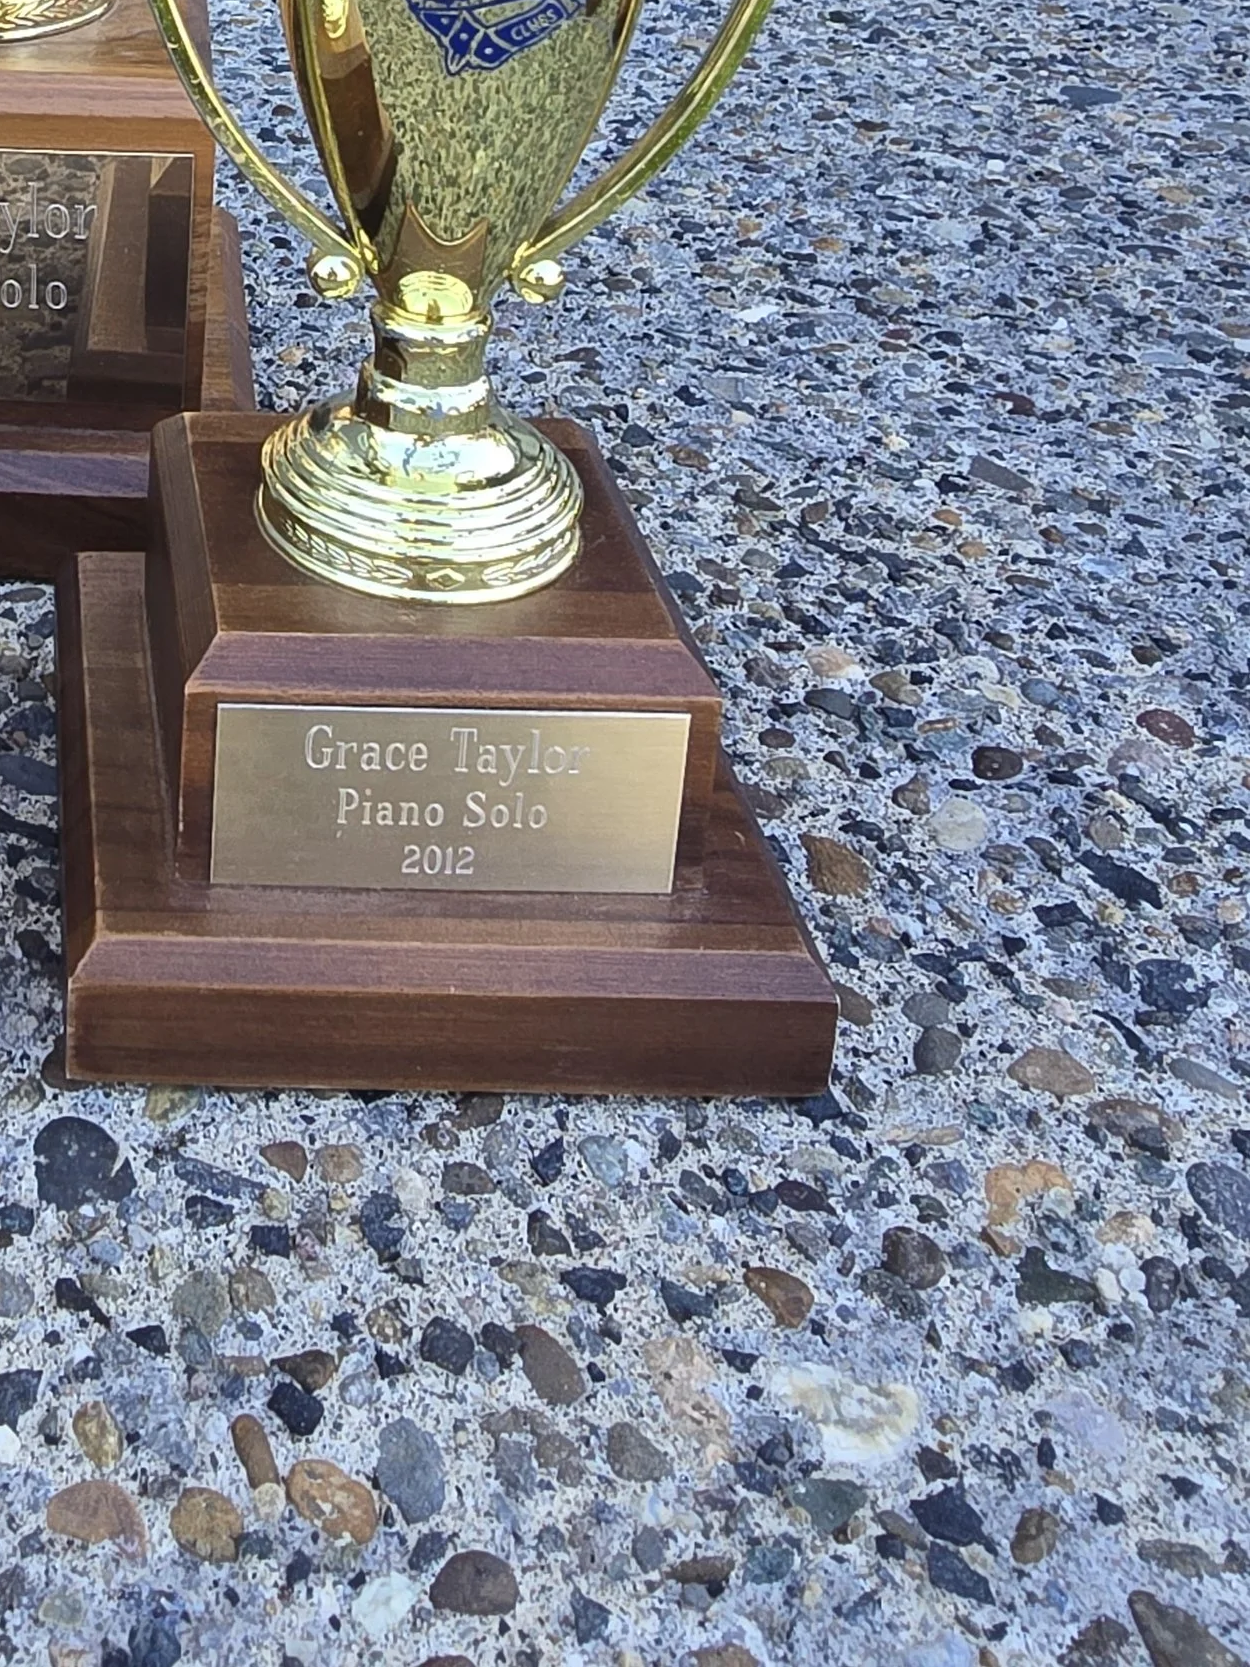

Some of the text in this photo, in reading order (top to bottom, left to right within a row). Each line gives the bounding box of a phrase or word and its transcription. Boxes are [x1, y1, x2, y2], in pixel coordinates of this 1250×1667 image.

[510, 8, 558, 41] CLUBS
[304, 724, 591, 787] Grace Taylor
[336, 787, 548, 829] Piano Solo
[400, 845, 475, 875] 2012
